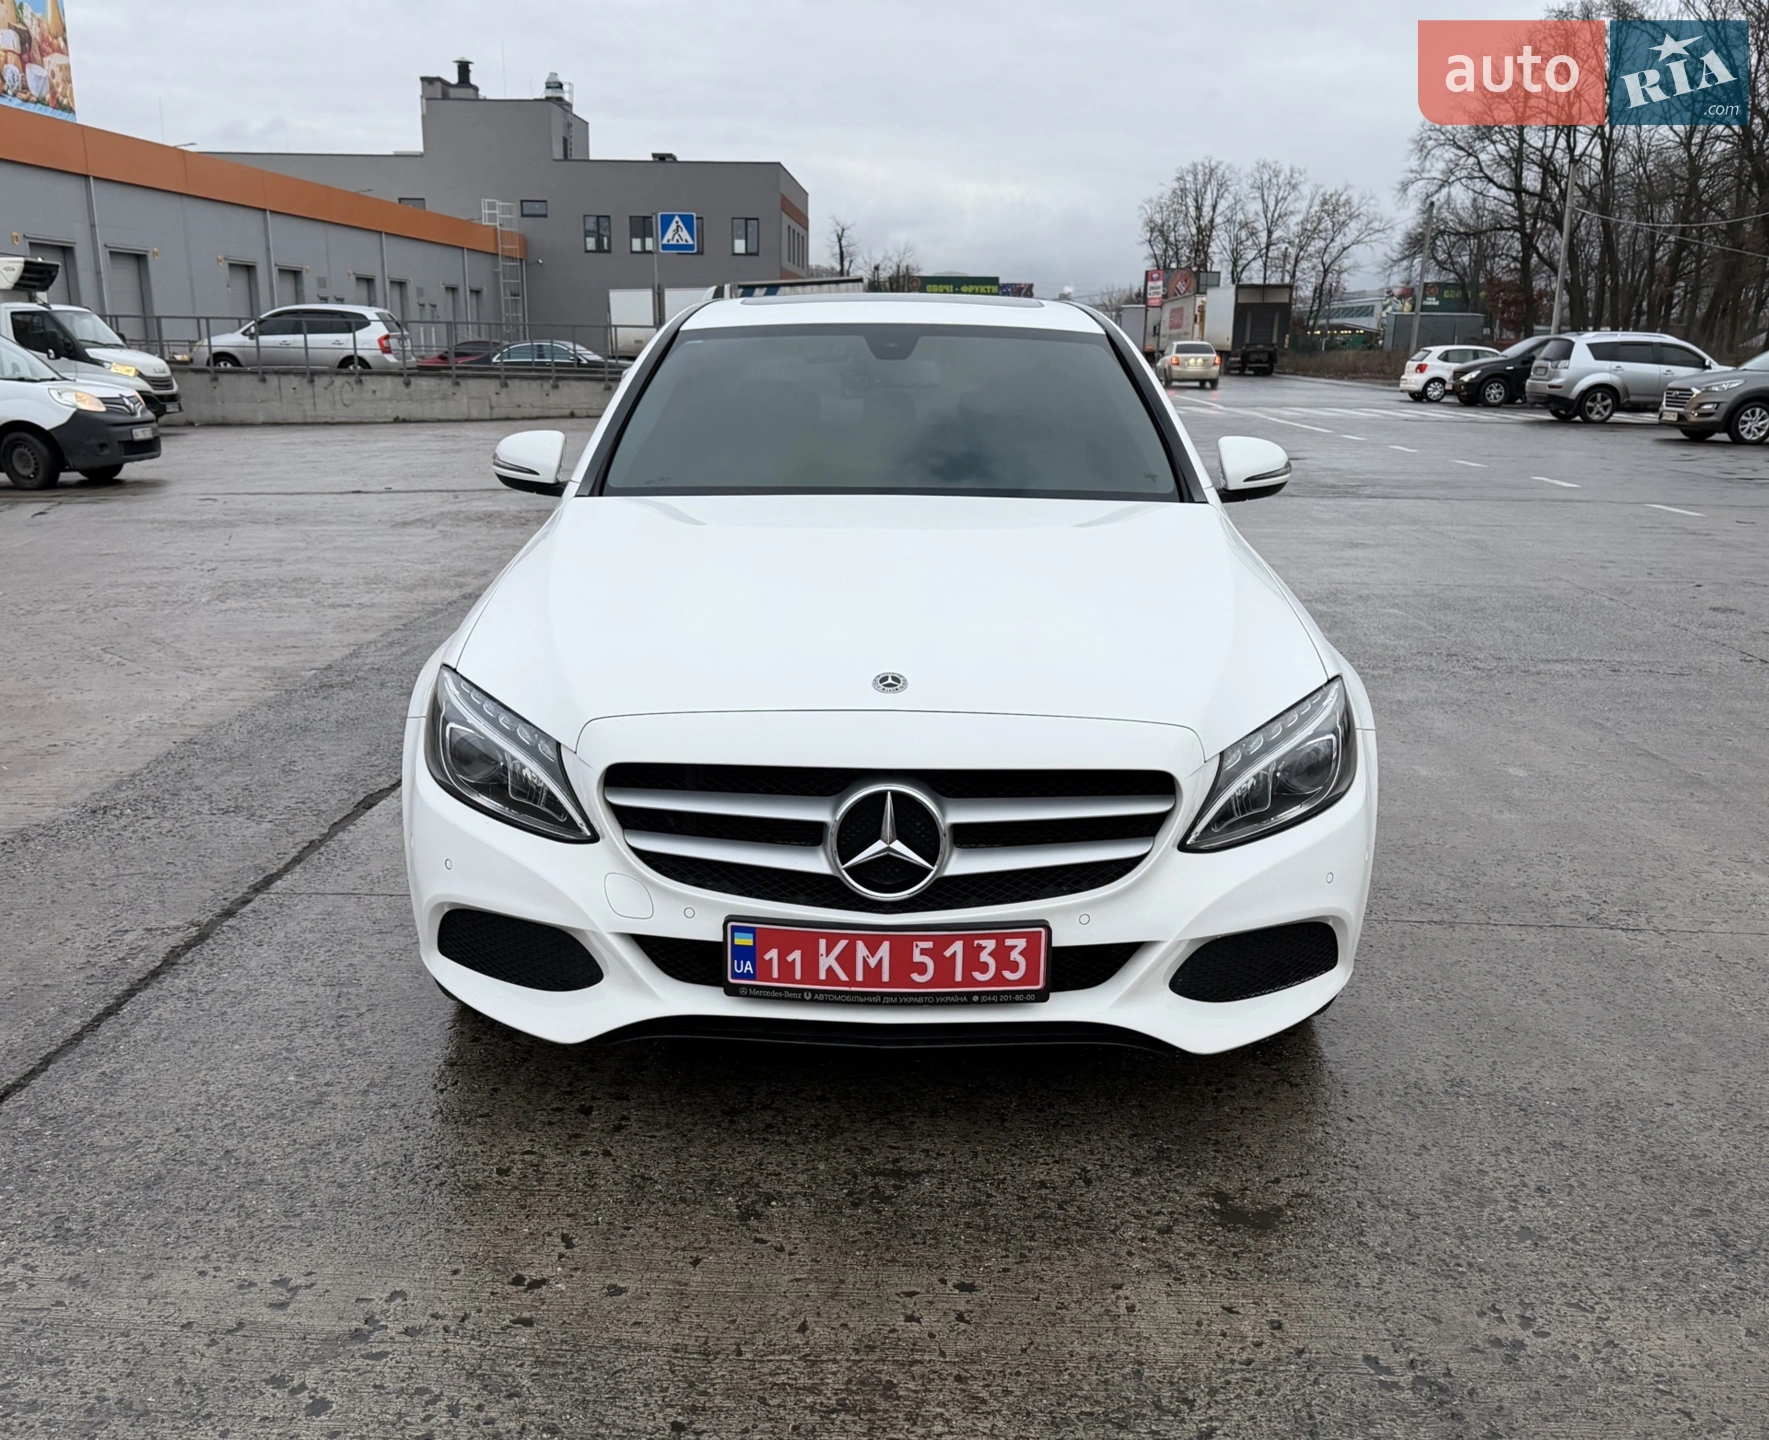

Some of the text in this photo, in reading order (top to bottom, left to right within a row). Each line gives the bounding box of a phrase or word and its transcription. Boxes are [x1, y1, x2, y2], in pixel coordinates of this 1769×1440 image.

[926, 284, 953, 293] ОВОЧІ
[961, 285, 998, 294] ФРУКТИ
[763, 938, 1027, 983] 11 KM 5133
[734, 960, 754, 974] UA
[749, 988, 802, 999] Mercedes-Benz
[813, 993, 881, 1003] АВТОМОБІЛЬНИЙ
